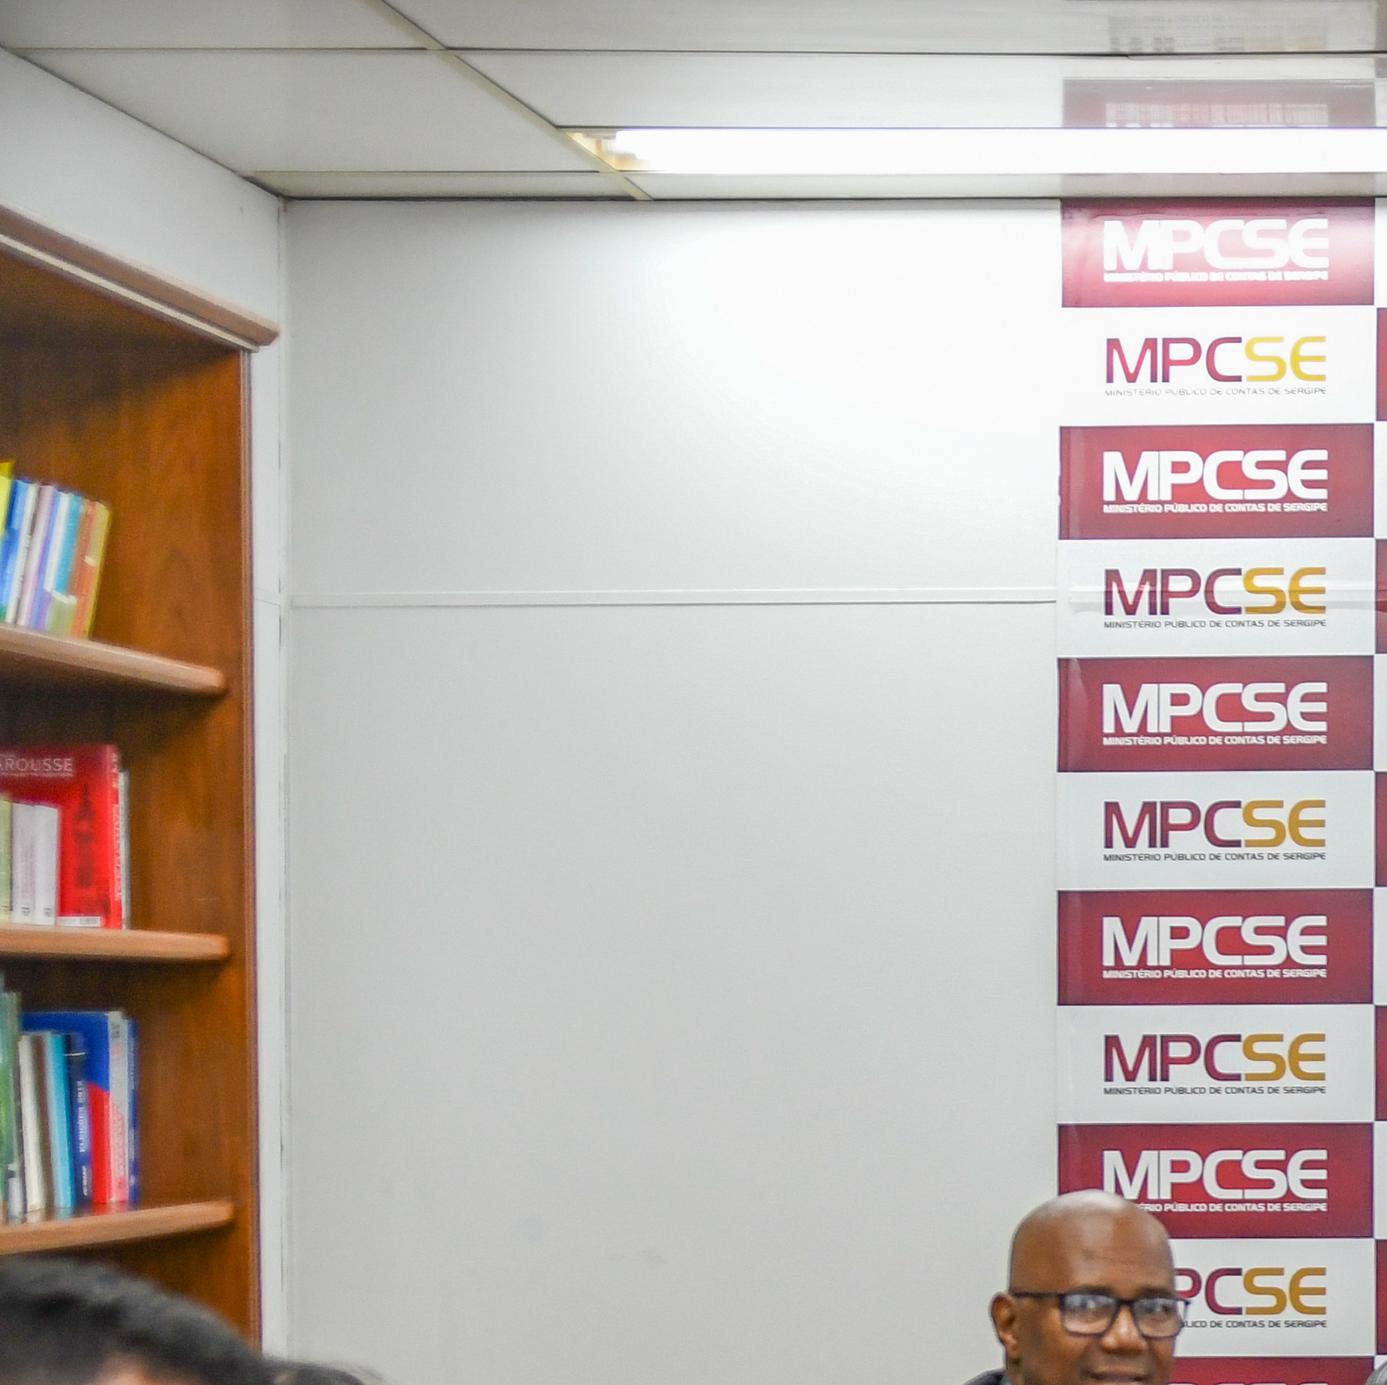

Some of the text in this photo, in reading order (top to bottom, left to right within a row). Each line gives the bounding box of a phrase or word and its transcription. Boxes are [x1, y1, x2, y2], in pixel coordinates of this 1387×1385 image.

[1103, 219, 1328, 270] MPCSE
[1107, 337, 1326, 382] MPCSE
[1104, 450, 1328, 500] MPCSE
[1210, 502, 1223, 513] DE
[1225, 502, 1266, 513] CONTAS
[1268, 502, 1282, 513] DE
[1284, 502, 1328, 513] SERGIPE
[1105, 568, 1325, 615] MPCSE
[1103, 683, 1327, 732] MPCSE
[1105, 800, 1325, 848] MPCSE
[1209, 853, 1222, 861] DE
[1224, 853, 1265, 861] CONTAS
[1267, 853, 1281, 861] DE
[1283, 853, 1326, 861] SERGIPE
[1103, 916, 1327, 966] MPCSE
[1105, 1034, 1325, 1081] MPCSE
[1209, 1086, 1222, 1095] DE
[1224, 1086, 1265, 1095] CONTAS
[1267, 1086, 1281, 1095] DE
[1283, 1086, 1326, 1095] SERGIPE
[1103, 1150, 1327, 1200] MPCSE
